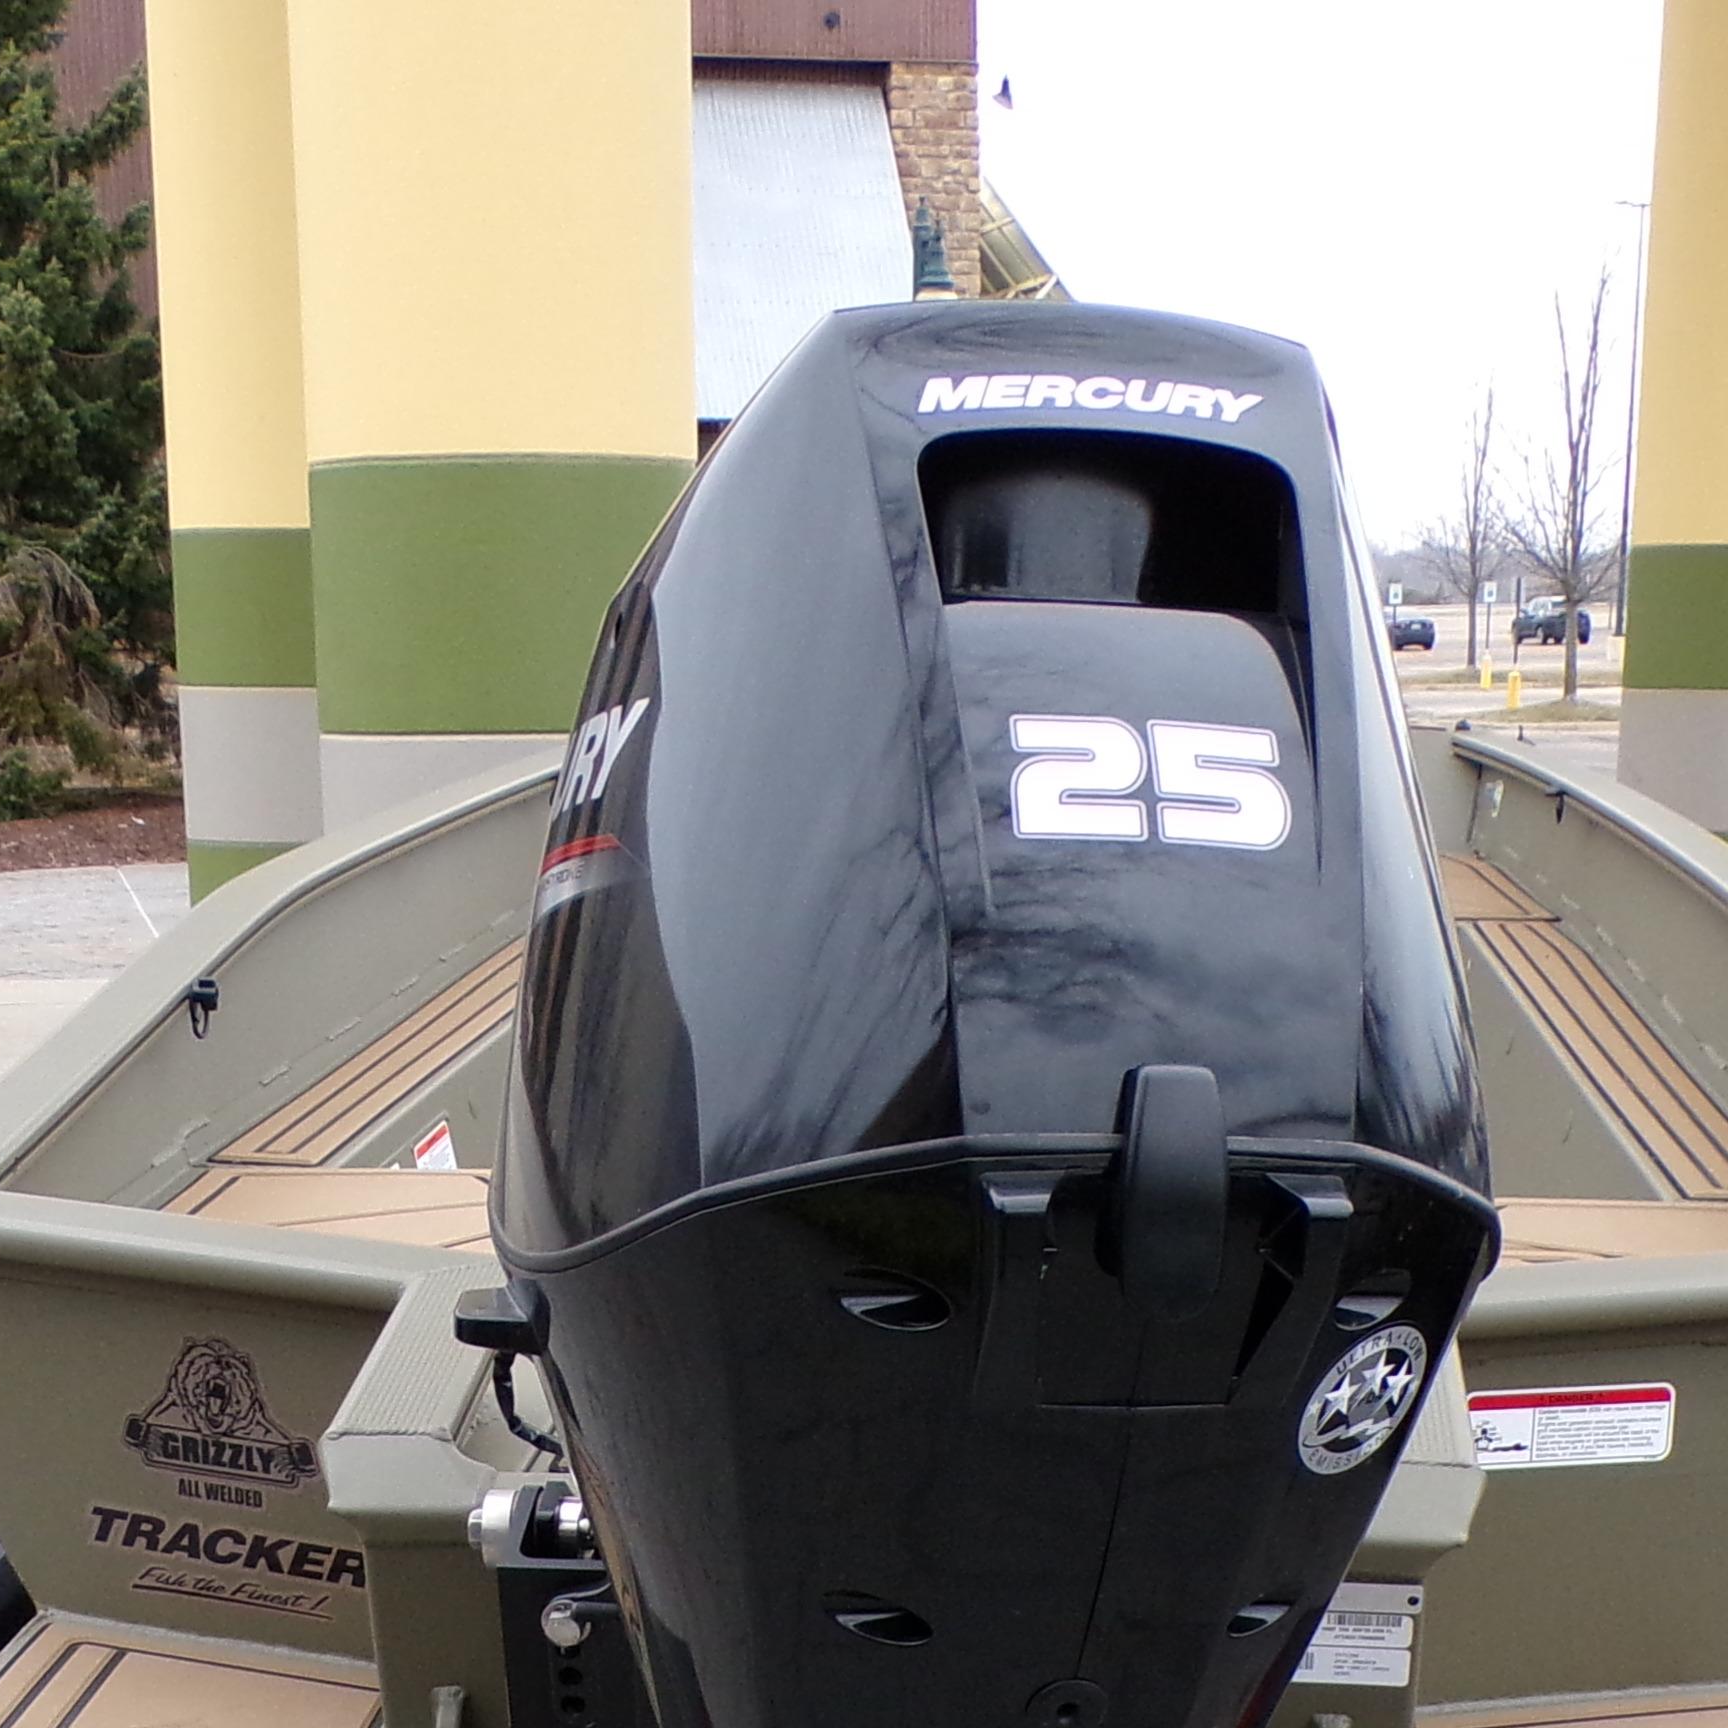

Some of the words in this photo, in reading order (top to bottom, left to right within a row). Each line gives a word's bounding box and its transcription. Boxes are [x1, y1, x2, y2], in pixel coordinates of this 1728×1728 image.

[916, 375, 1265, 423] MERCURY
[1008, 713, 1293, 851] 25
[160, 1431, 273, 1474] GRIZZLY
[177, 1477, 201, 1500] ALL
[204, 1481, 264, 1509] WELDED
[90, 1506, 367, 1589] TRACKER
[137, 1567, 187, 1588] Fish
[192, 1576, 227, 1595] the
